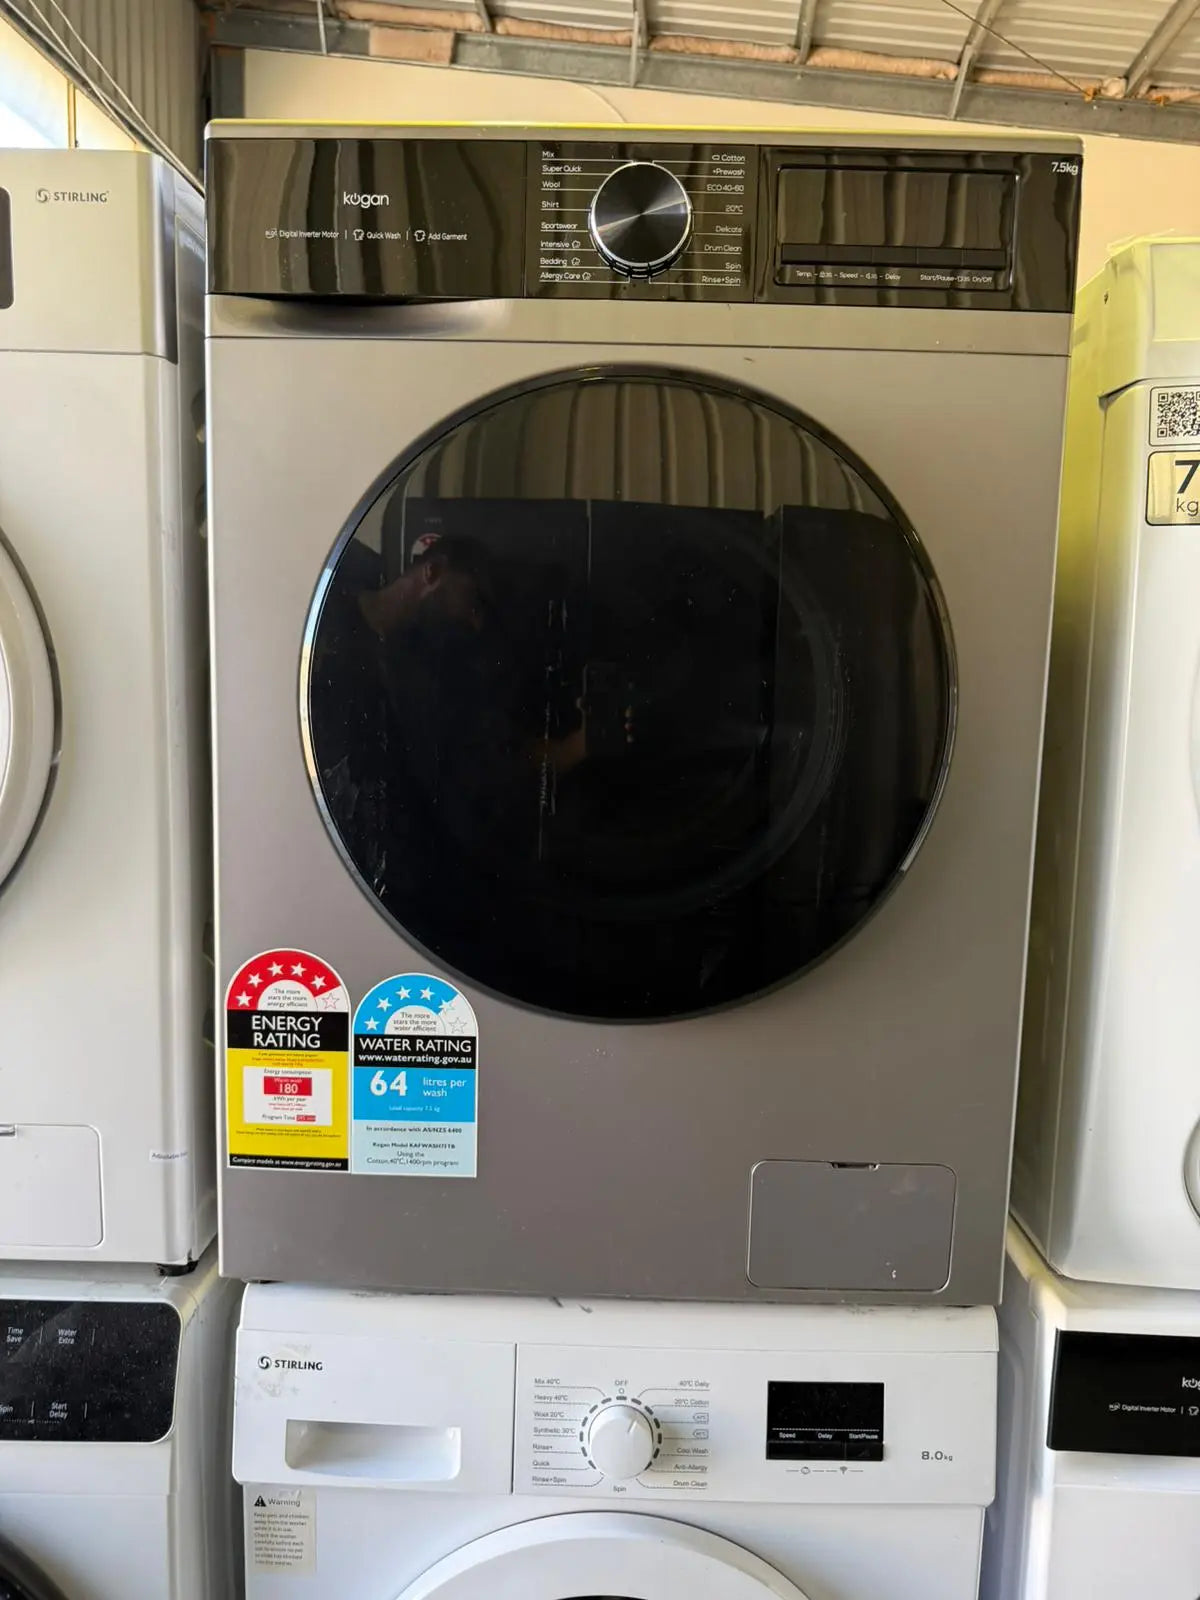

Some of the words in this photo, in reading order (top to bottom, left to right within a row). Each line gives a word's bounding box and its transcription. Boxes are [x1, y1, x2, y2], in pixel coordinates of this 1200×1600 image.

[721, 154, 745, 162] Cotton
[542, 165, 563, 173] Super
[563, 165, 582, 173] Quick
[712, 168, 745, 176] +Prewash
[1051, 162, 1078, 176] 7.5kg
[707, 184, 722, 192] ECO
[53, 191, 108, 203] STIRLING
[343, 191, 389, 208] kogan
[541, 222, 578, 230] Sportswear
[715, 225, 743, 233] Delicate
[279, 229, 298, 238] Digital
[299, 230, 321, 238] Inverter
[322, 230, 339, 238] Motor
[367, 231, 384, 240] Quick
[384, 231, 401, 240] Wash
[428, 232, 441, 240] Add
[441, 232, 468, 240] Garment
[540, 240, 569, 248] Intensive
[704, 244, 722, 252] Drum
[722, 244, 742, 252] Clean
[540, 257, 567, 266] Bedding
[725, 262, 741, 270] Spin
[540, 272, 563, 281] Allergy
[564, 272, 580, 280] Care
[839, 271, 858, 279] Speed
[701, 276, 741, 284] Rinse+Spin
[1176, 498, 1199, 517] kg
[252, 1015, 323, 1032] ENERGY
[253, 1032, 320, 1048] RATING
[359, 1037, 411, 1051] WATER
[416, 1039, 471, 1052] RATING
[358, 1053, 472, 1065] www.waterrating.gov.au
[370, 1070, 408, 1096] 64
[423, 1077, 447, 1087] litres
[449, 1079, 467, 1088] per
[279, 1083, 299, 1094] 180
[423, 1088, 448, 1097] wash
[7, 1327, 24, 1335] Time
[58, 1328, 77, 1336] Water
[6, 1335, 22, 1343] Save
[58, 1337, 75, 1345] Extra
[274, 1359, 324, 1371] STIRLING
[51, 1402, 68, 1411] Start
[50, 1410, 68, 1419] Delay
[818, 1432, 833, 1440] Delay
[921, 1450, 953, 1461] 8.0kg
[613, 1485, 627, 1493] Spin
[268, 1498, 301, 1508] Warning
